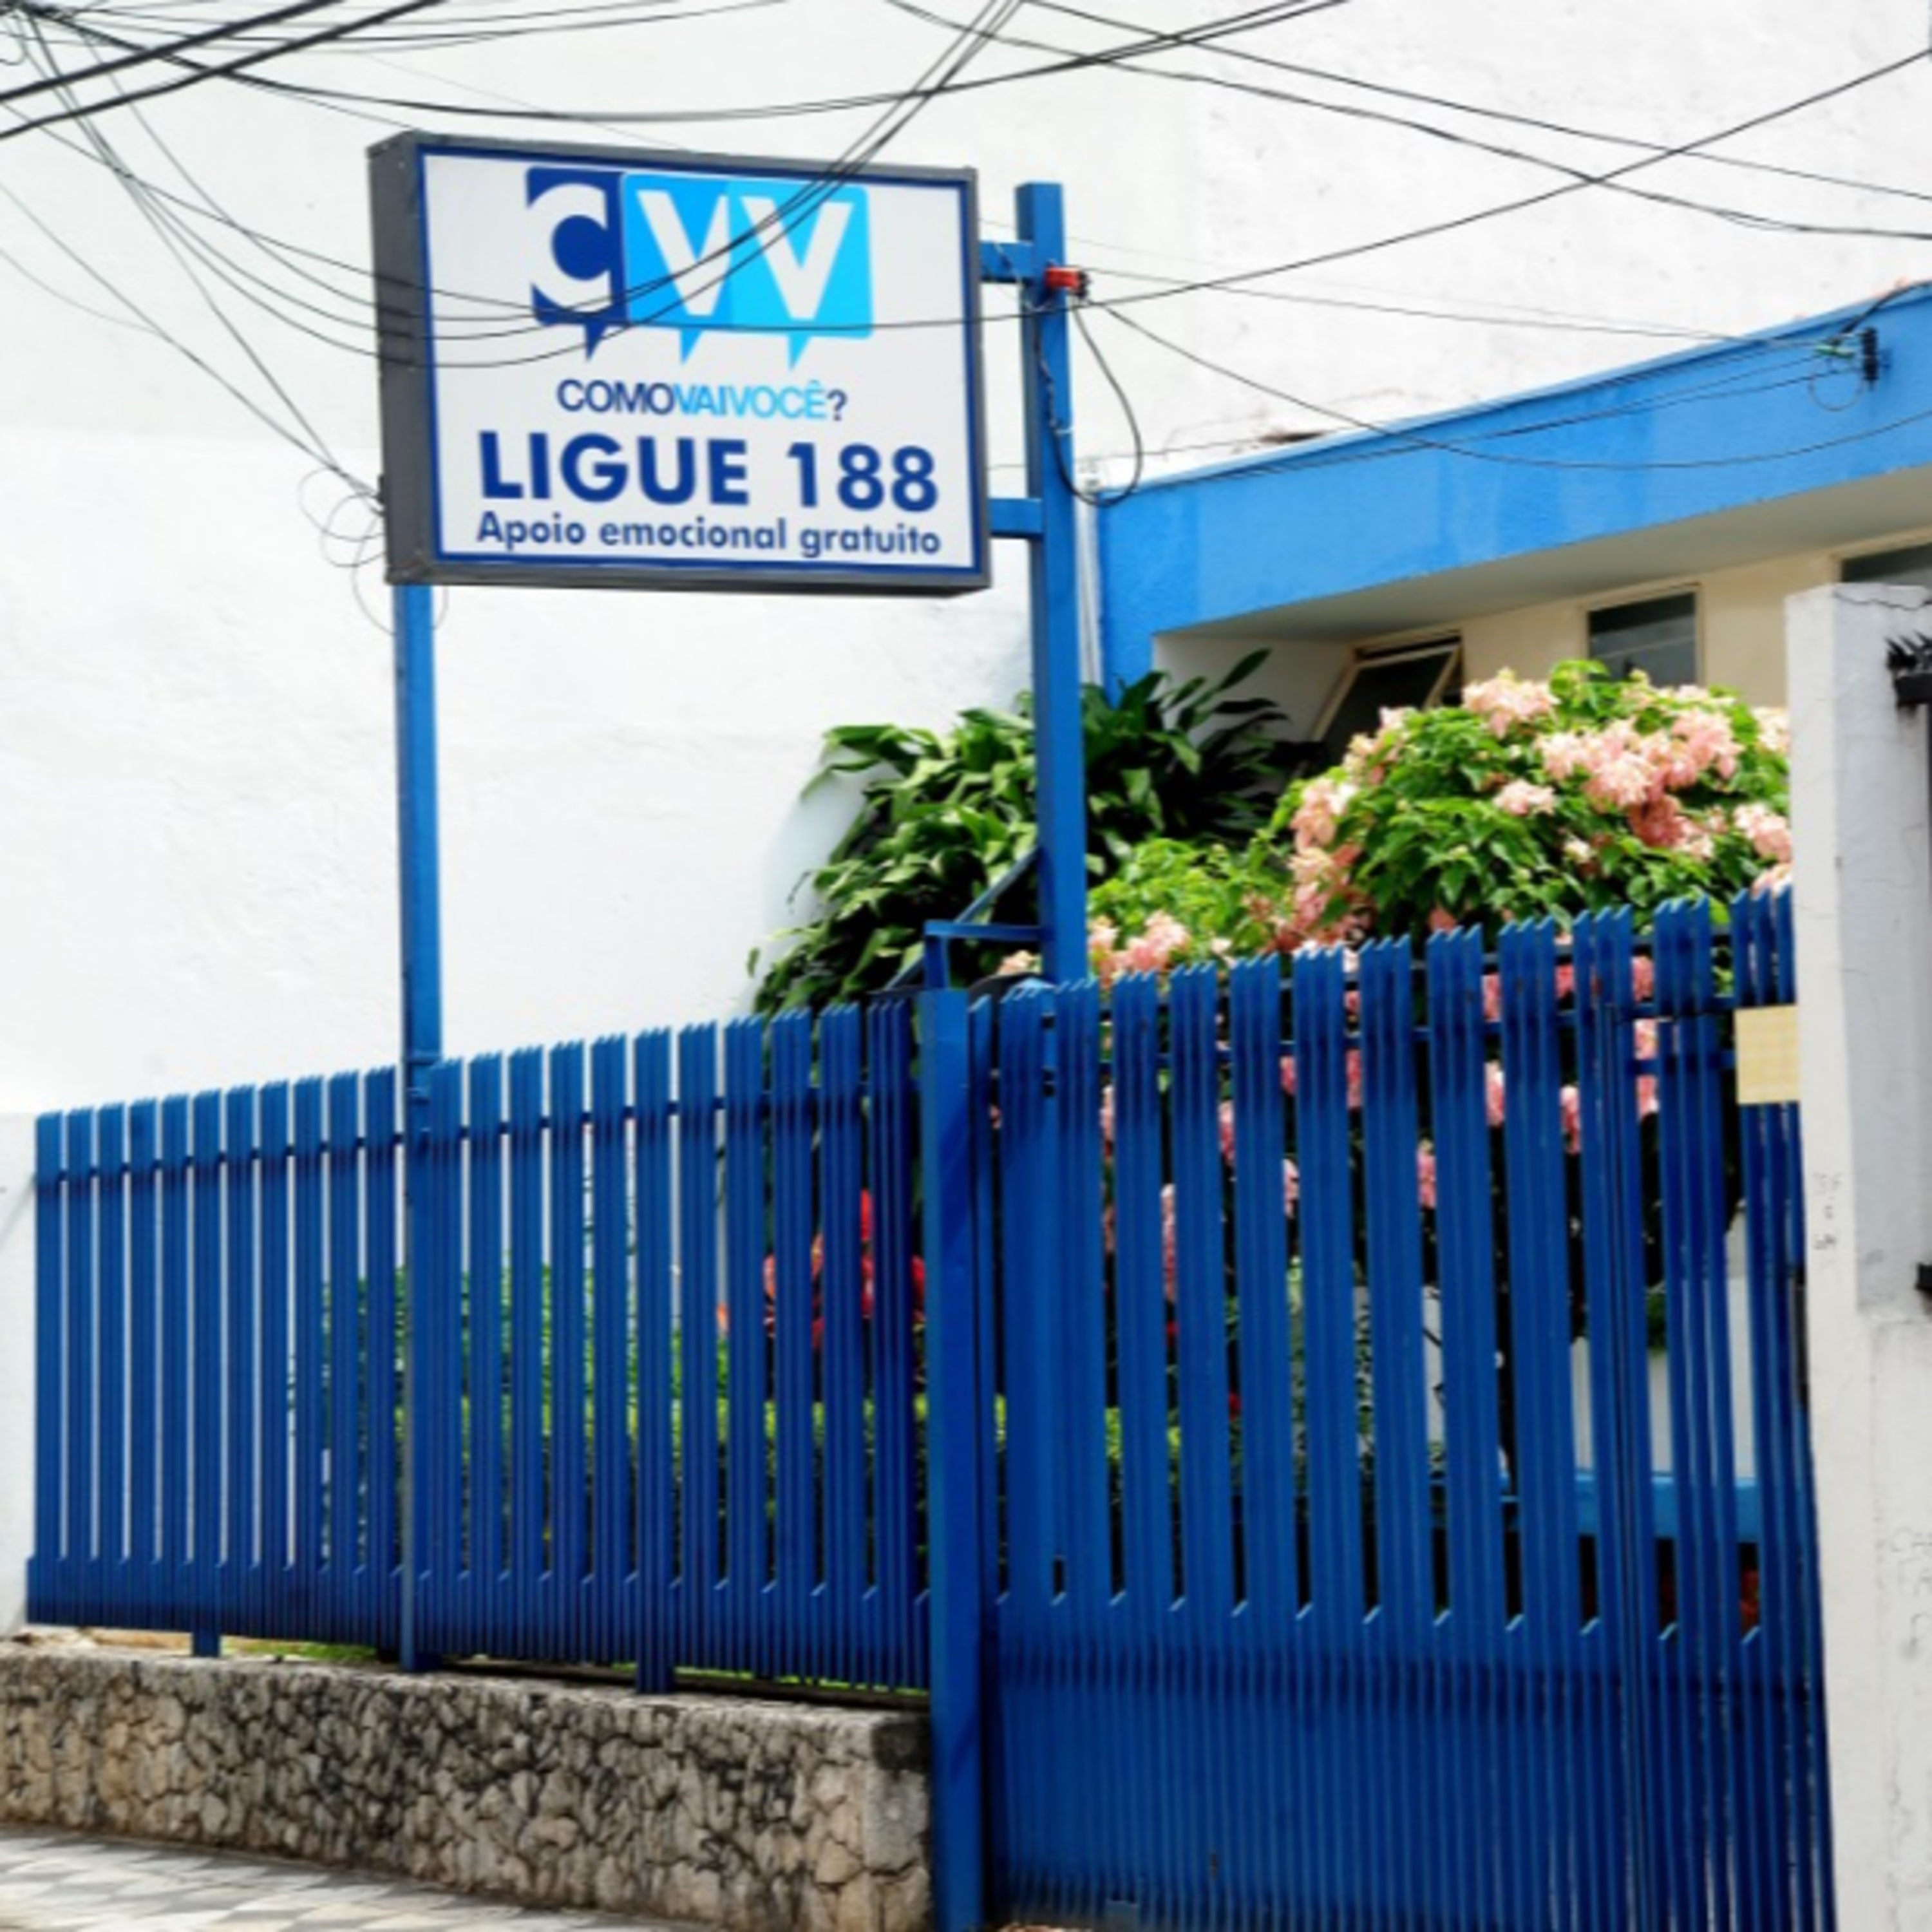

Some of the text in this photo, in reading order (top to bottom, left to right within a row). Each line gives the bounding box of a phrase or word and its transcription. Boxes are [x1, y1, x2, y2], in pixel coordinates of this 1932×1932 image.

[528, 183, 855, 321] CVV
[478, 430, 940, 513] LIGUE 188
[476, 510, 941, 558] Apoio emocional gratuito
